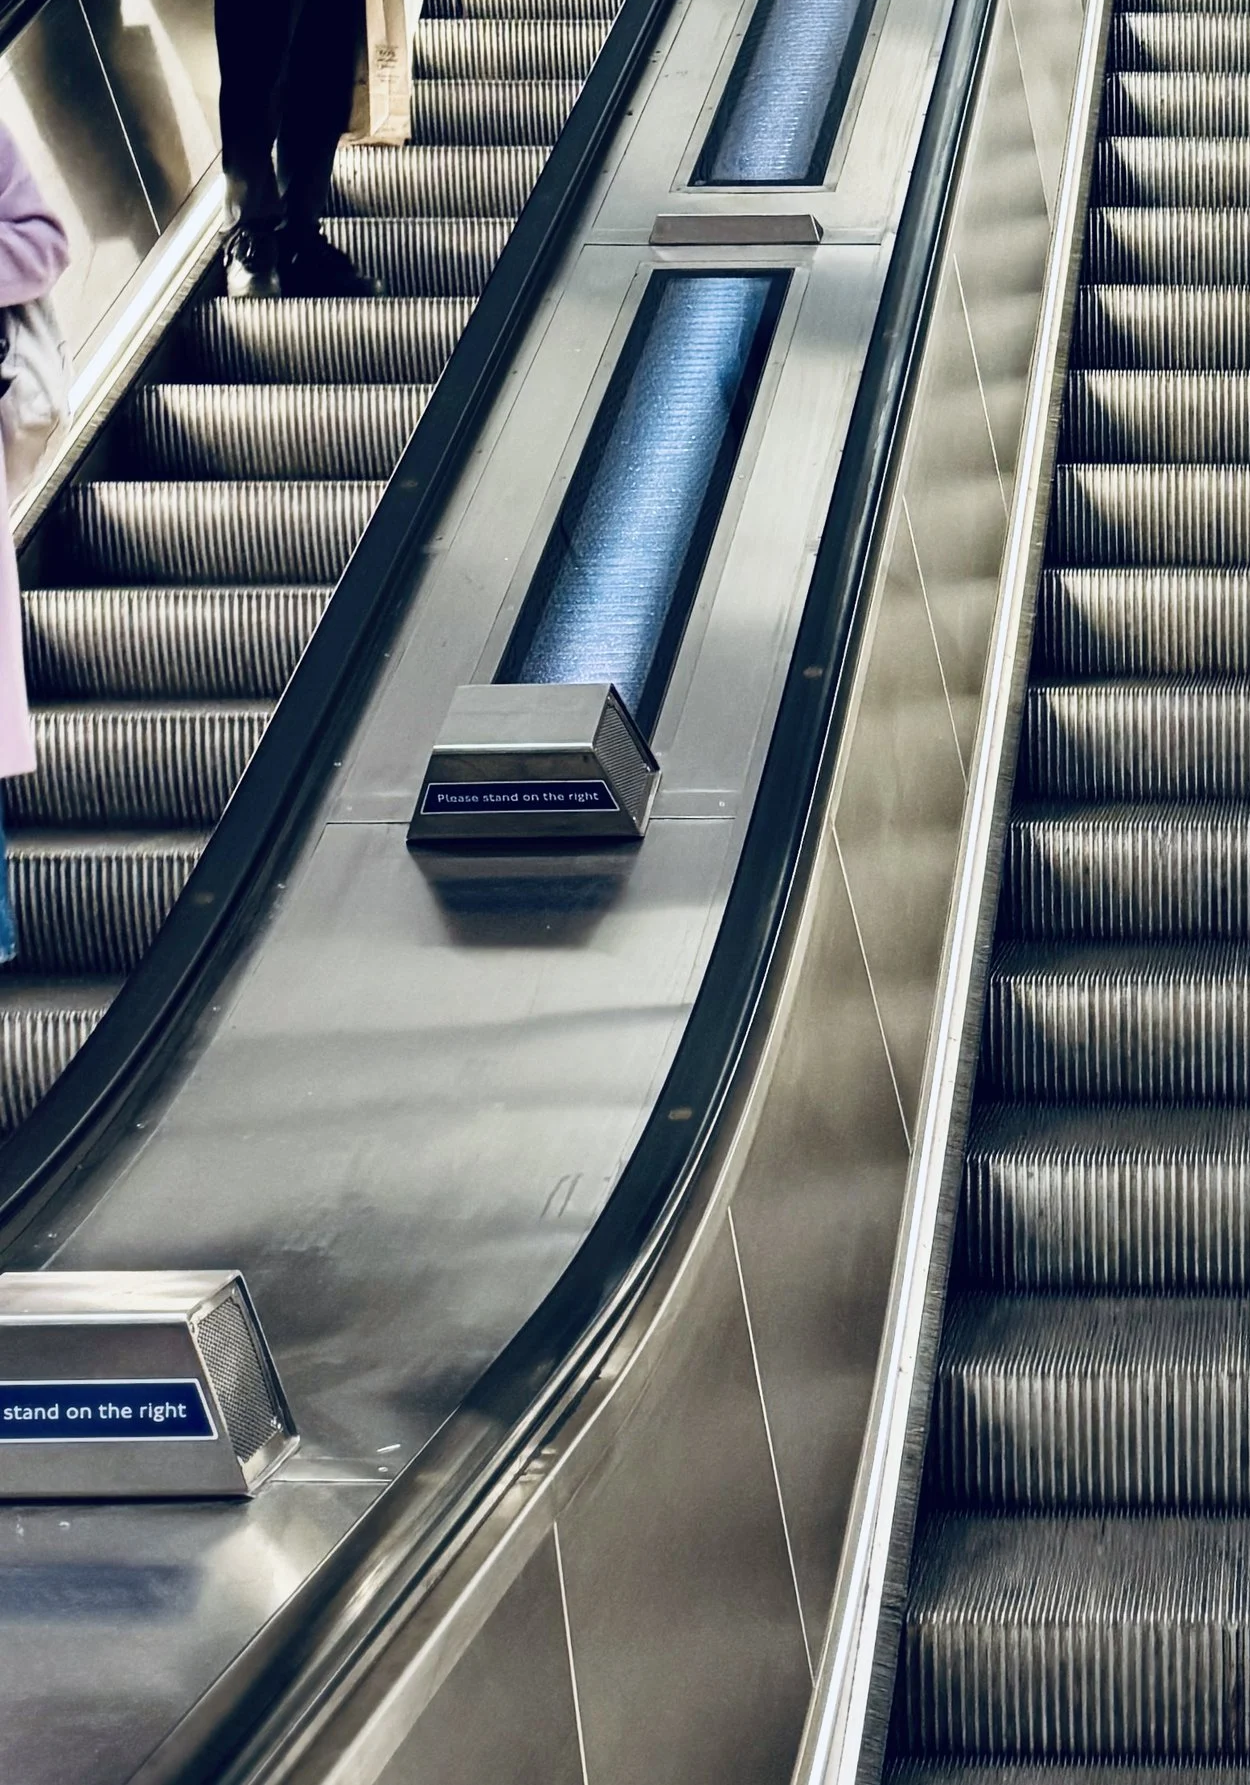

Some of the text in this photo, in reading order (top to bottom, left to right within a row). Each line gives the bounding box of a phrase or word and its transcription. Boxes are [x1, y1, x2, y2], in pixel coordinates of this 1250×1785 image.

[437, 791, 599, 803] Please stand on the right
[3, 1401, 187, 1423] stand on the right
